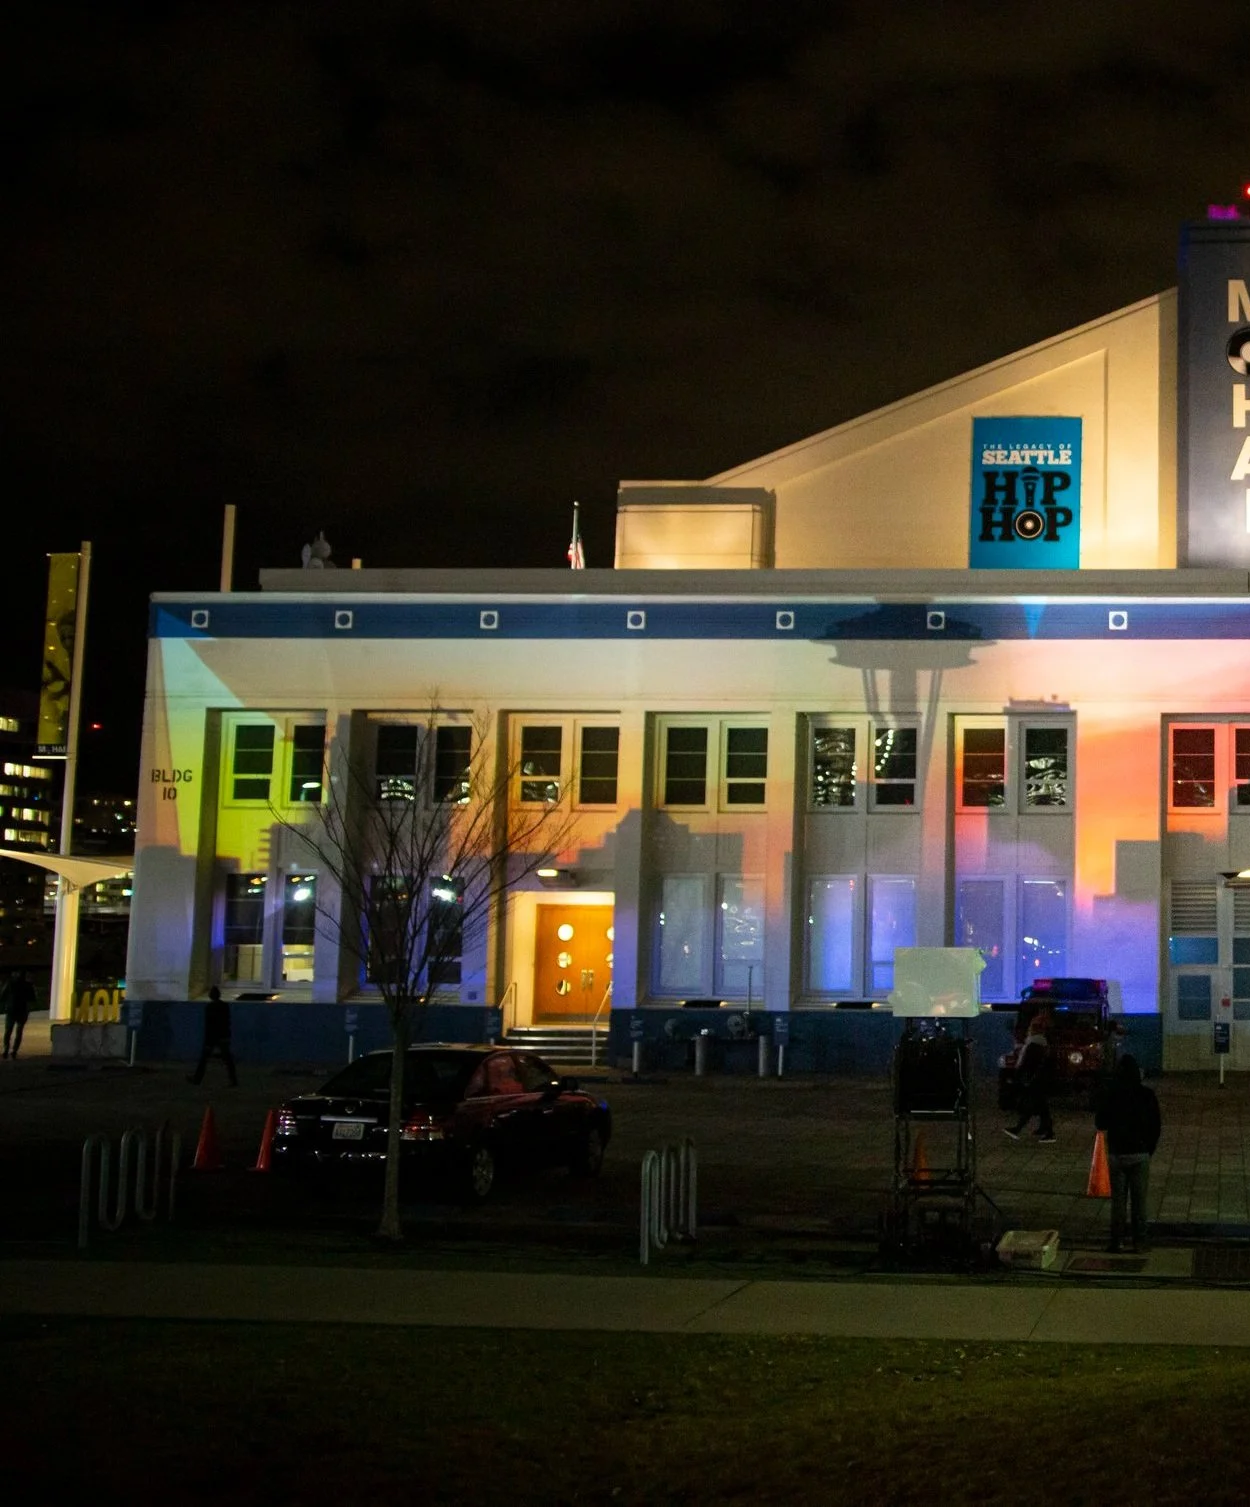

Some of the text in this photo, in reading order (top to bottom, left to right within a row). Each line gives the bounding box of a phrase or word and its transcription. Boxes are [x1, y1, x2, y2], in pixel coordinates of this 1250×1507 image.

[981, 449, 1072, 465] SEATTLE
[982, 466, 1072, 506] HIP
[978, 507, 1073, 542] HOP
[151, 769, 193, 783] BLDG
[163, 787, 177, 801] 10
